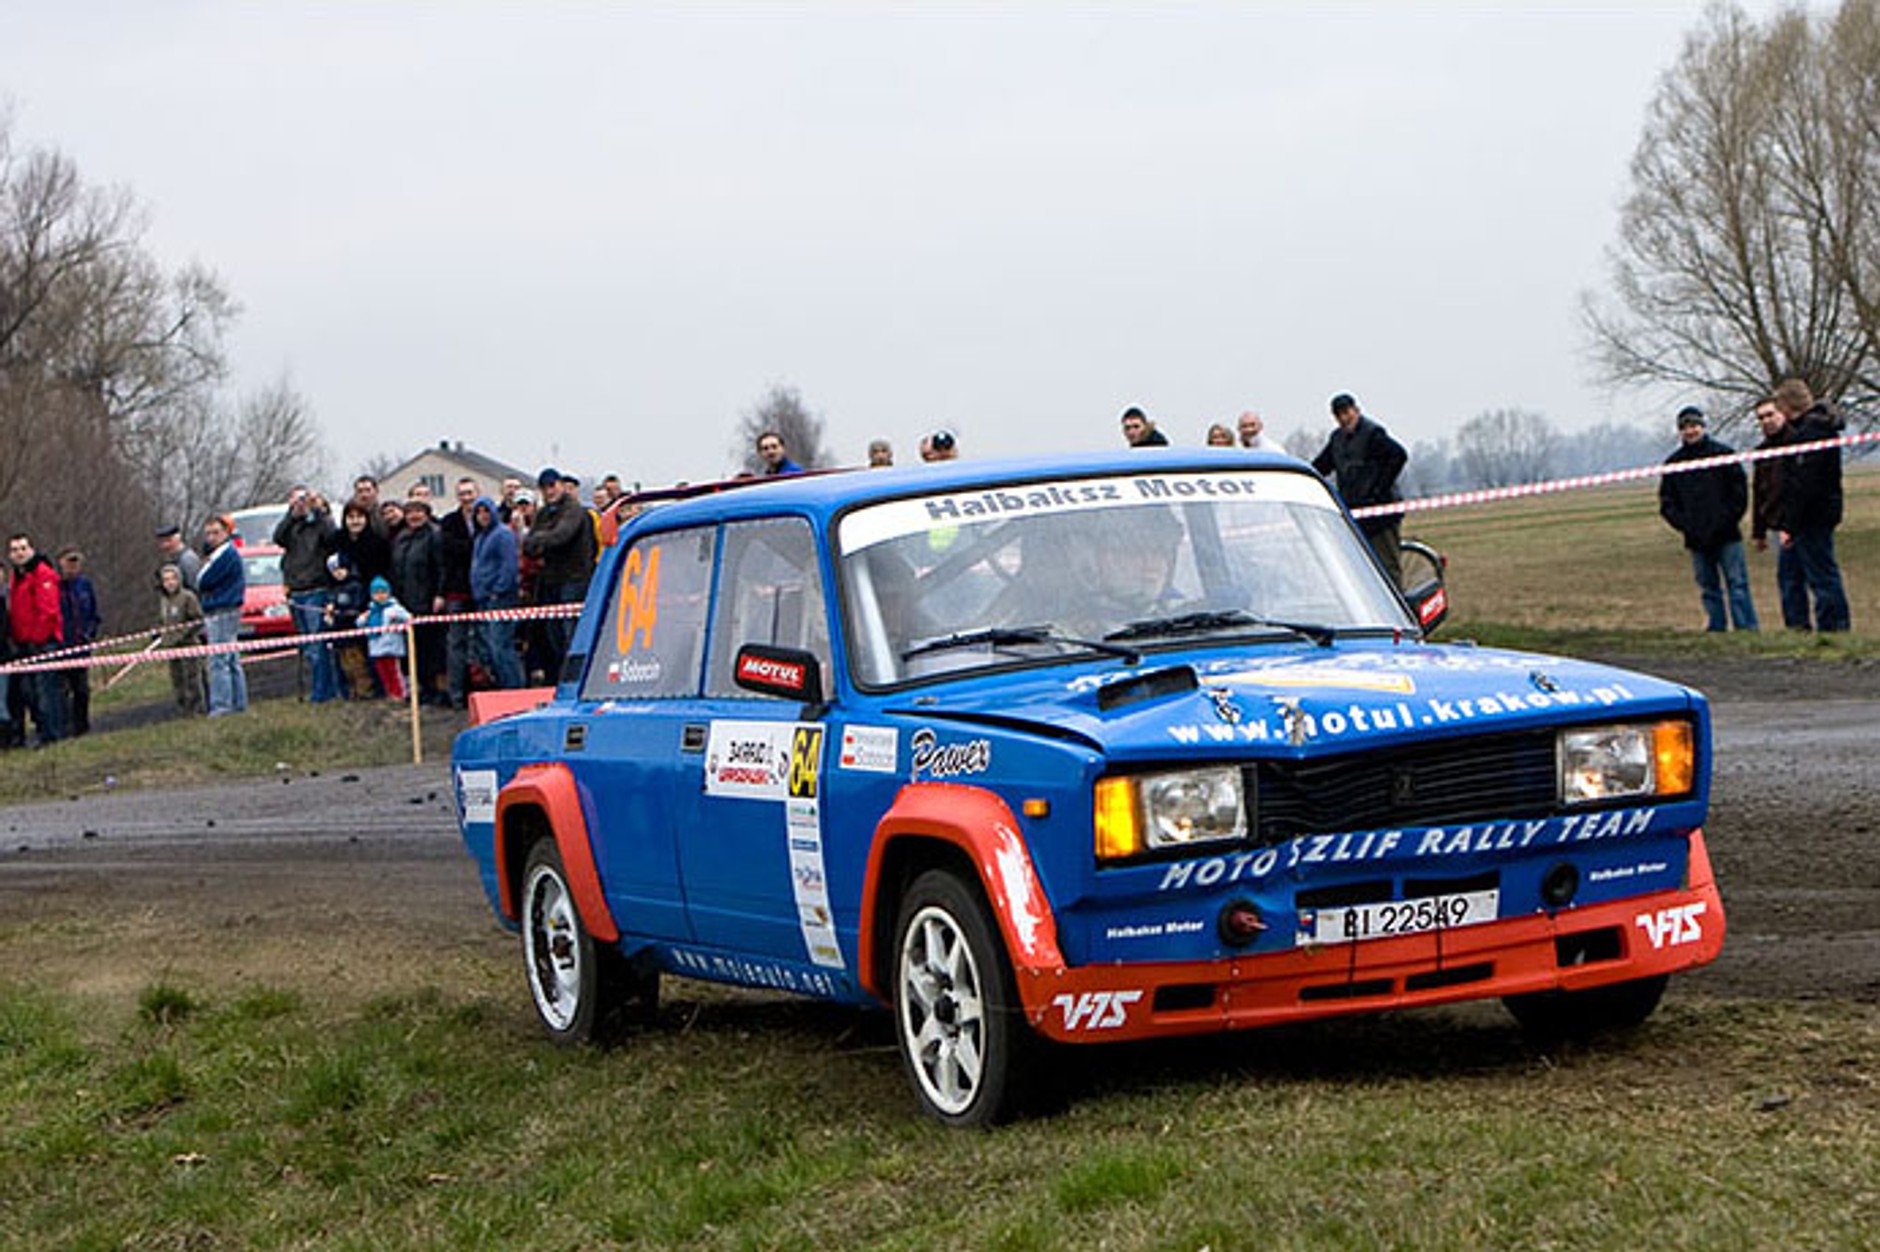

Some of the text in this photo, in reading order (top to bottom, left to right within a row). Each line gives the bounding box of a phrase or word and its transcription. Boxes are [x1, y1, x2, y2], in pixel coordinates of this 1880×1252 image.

[925, 477, 1257, 520] Halbaksz Motor
[617, 546, 661, 655] 64
[743, 659, 800, 682] MOTUL
[789, 728, 823, 798] 64
[1157, 808, 1655, 890] MOTO SZLIF RALLY TEAM
